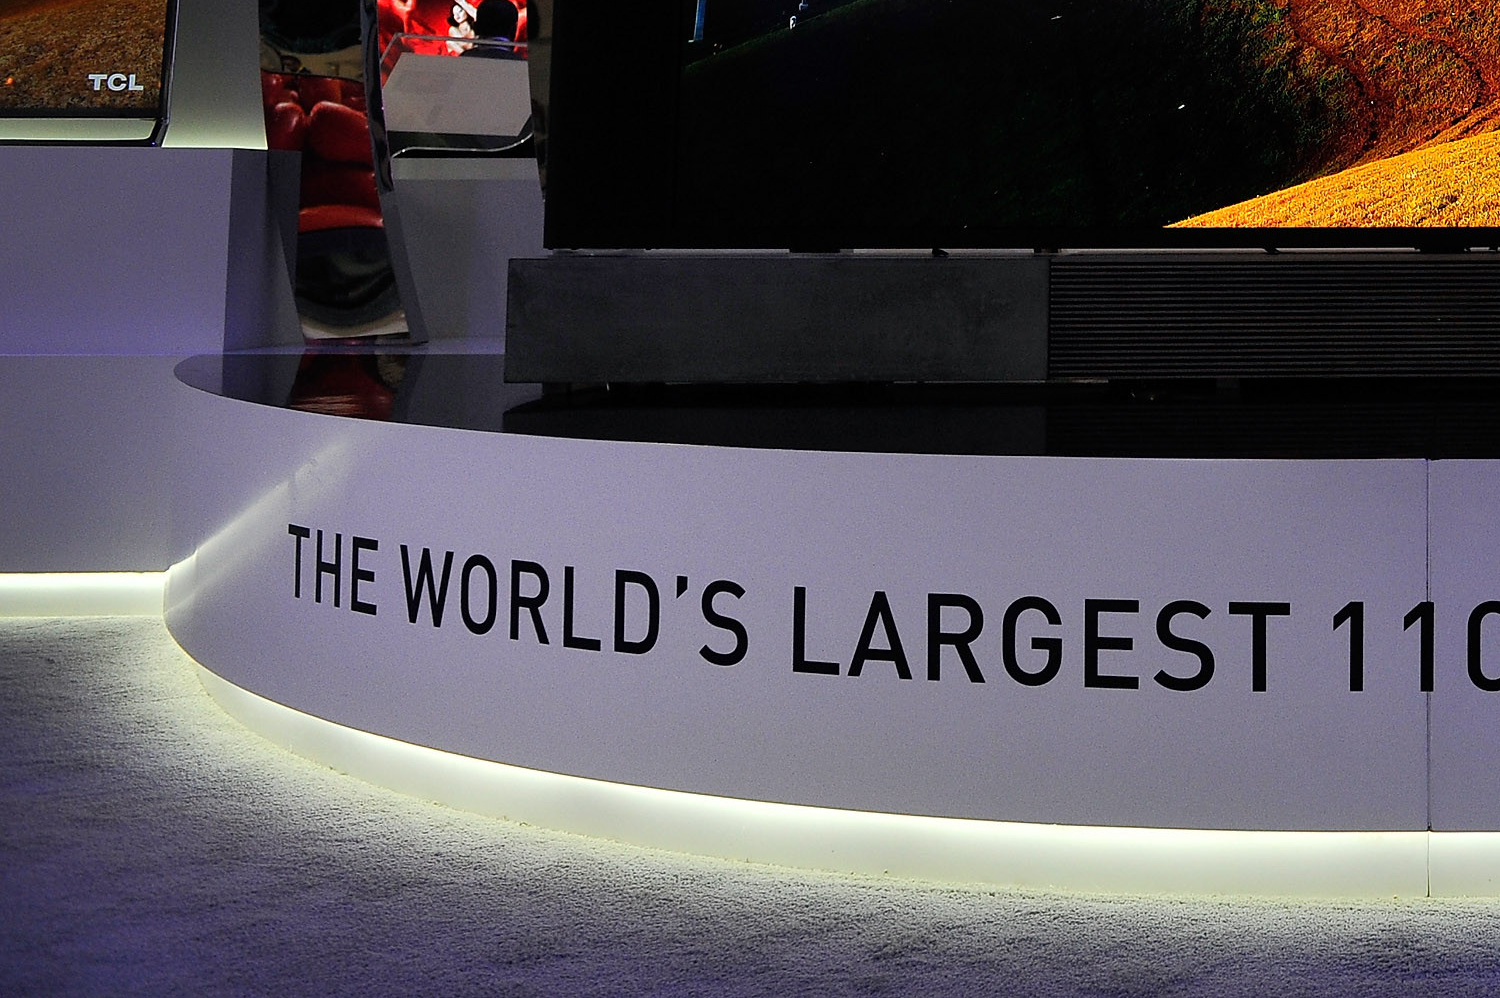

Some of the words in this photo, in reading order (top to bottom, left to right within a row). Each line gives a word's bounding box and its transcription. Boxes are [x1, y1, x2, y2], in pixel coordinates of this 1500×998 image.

[88, 73, 144, 91] TCL
[288, 523, 379, 616] THE
[400, 544, 749, 668] WORLD'S
[792, 586, 1291, 692] LARGEST
